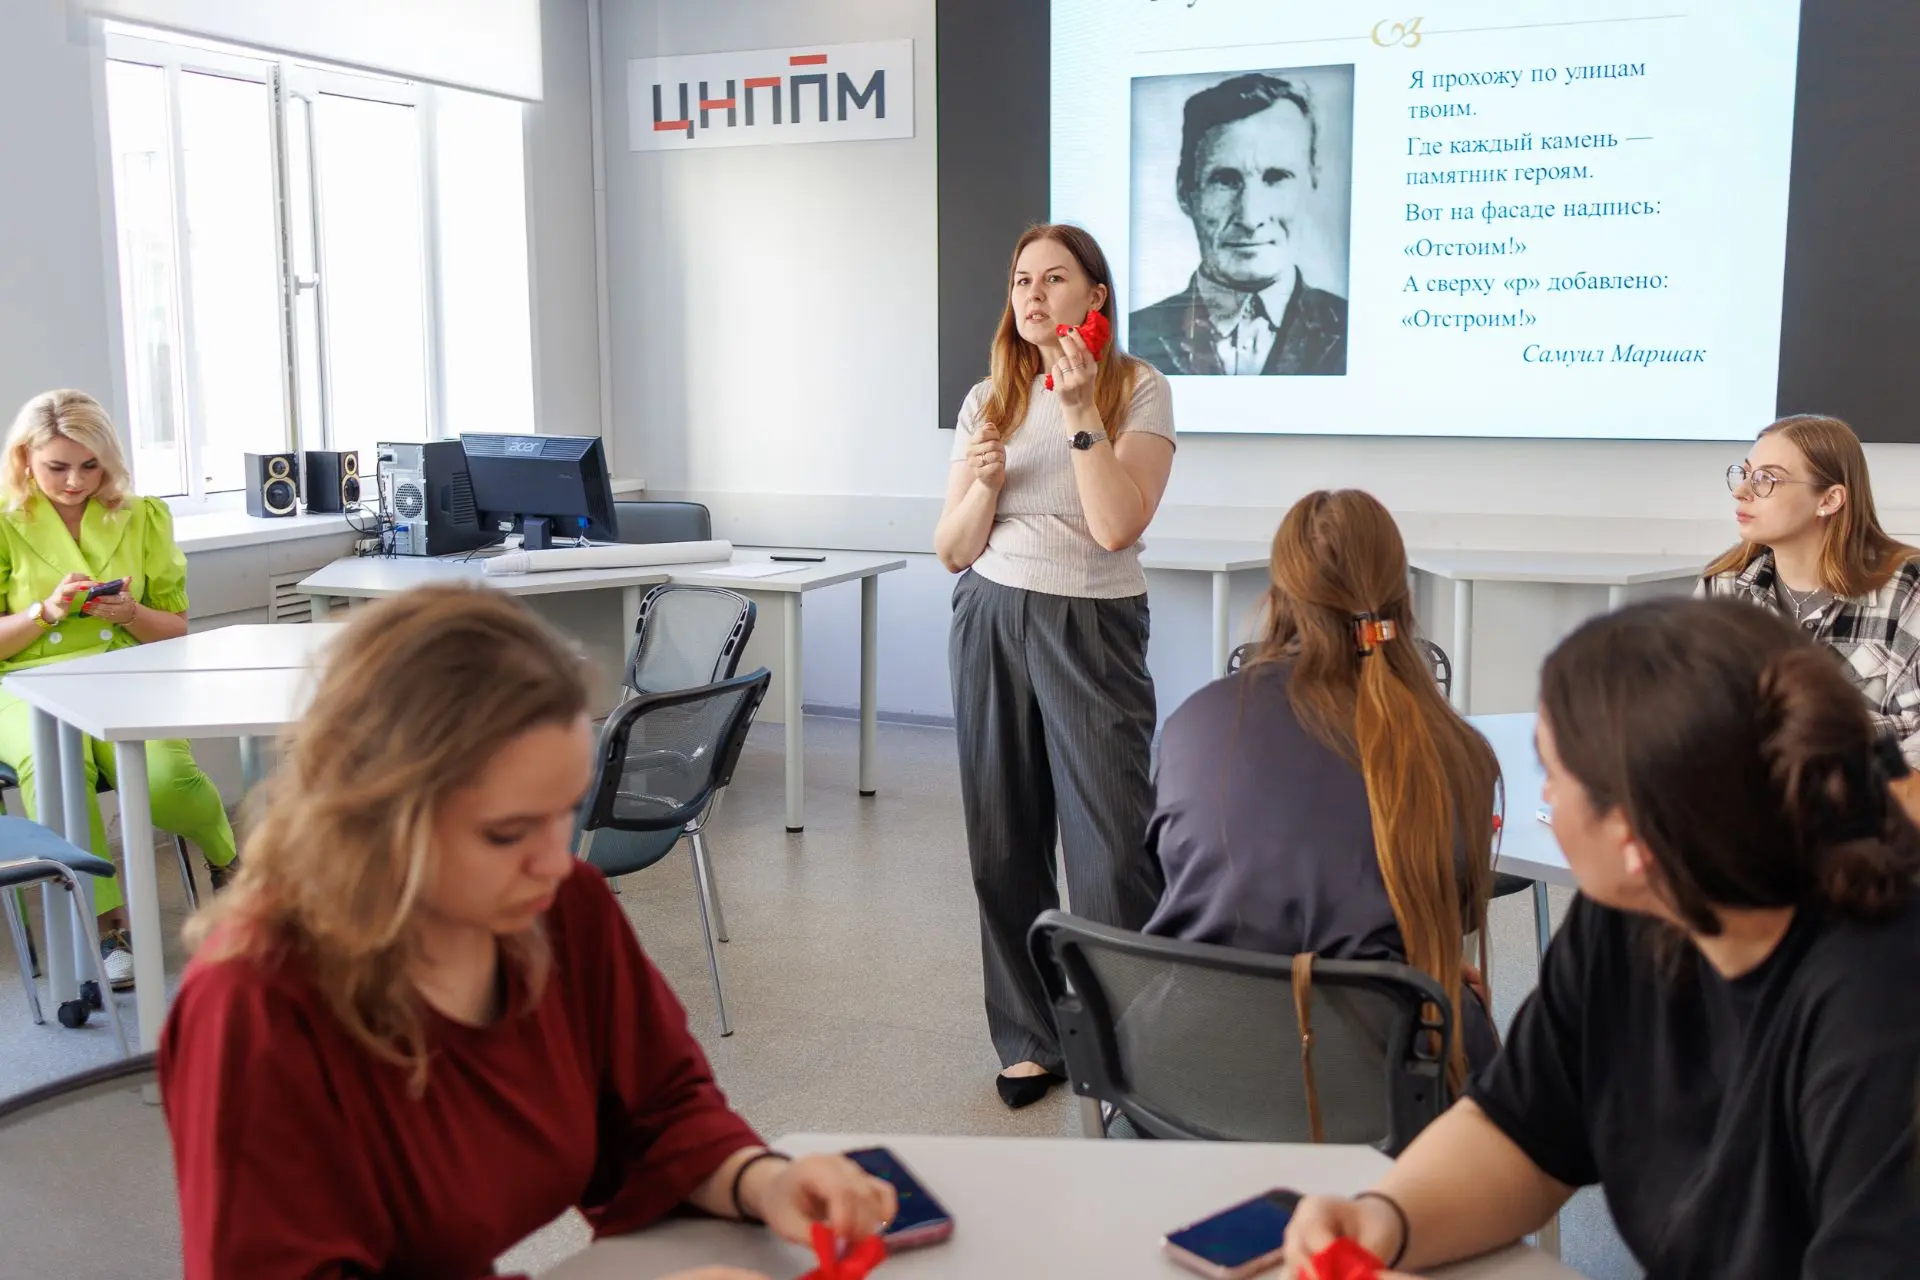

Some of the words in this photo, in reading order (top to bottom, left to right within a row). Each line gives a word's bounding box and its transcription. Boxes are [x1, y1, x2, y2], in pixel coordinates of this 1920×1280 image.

[1408, 70, 1425, 90] Я
[1431, 69, 1524, 92] прохожу
[1531, 67, 1558, 84] по
[1564, 62, 1646, 86] улицам
[652, 54, 886, 140] ЦНППМ
[1407, 102, 1478, 120] твоим.
[1406, 136, 1443, 157] Где
[1449, 132, 1533, 154] каждый
[1540, 133, 1619, 151] камень
[1406, 168, 1509, 186] памятник
[1514, 165, 1595, 186] героям.
[1405, 202, 1444, 222] Вот
[1450, 206, 1475, 221] на
[1481, 199, 1556, 225] фасаде
[1563, 200, 1661, 218] надпись:
[1403, 236, 1528, 258] «Отстоим!»
[1402, 274, 1420, 293] А
[1426, 277, 1496, 297] сверху
[1503, 277, 1541, 297] «р»
[1547, 271, 1669, 293] добавлено:
[1401, 308, 1537, 333] «Отстроим!»
[1522, 343, 1605, 368] Самуил
[1610, 344, 1708, 369] Маршак
[509, 441, 540, 453] acer
